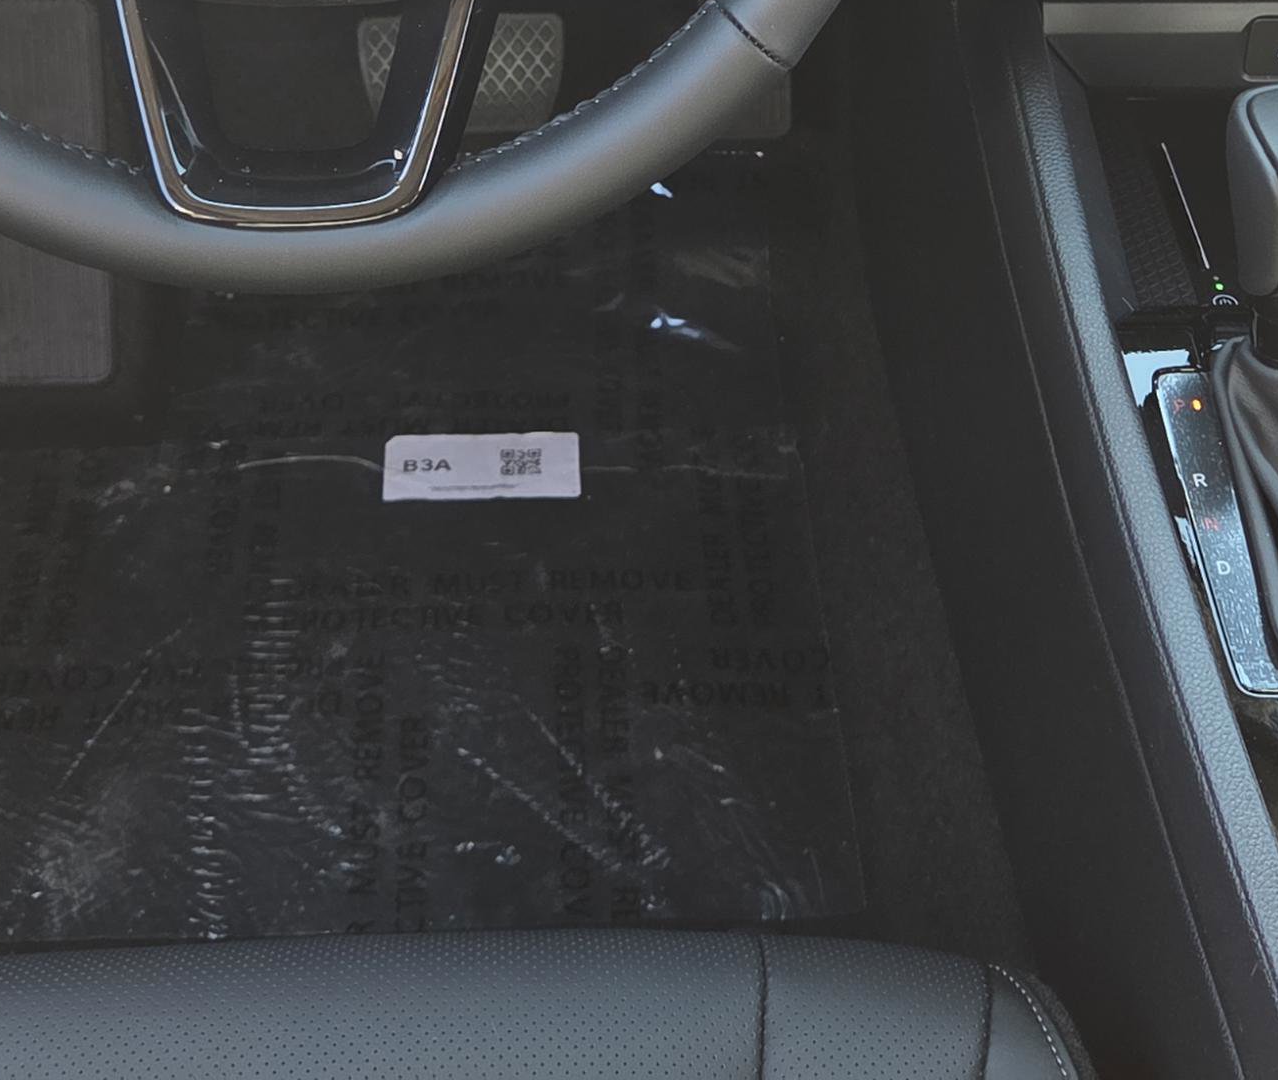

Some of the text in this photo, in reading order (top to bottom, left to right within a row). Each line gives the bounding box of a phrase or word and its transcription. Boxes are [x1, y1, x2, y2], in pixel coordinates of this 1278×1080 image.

[403, 459, 451, 473] B3A
[1193, 473, 1208, 488] R
[1217, 560, 1231, 576] D
